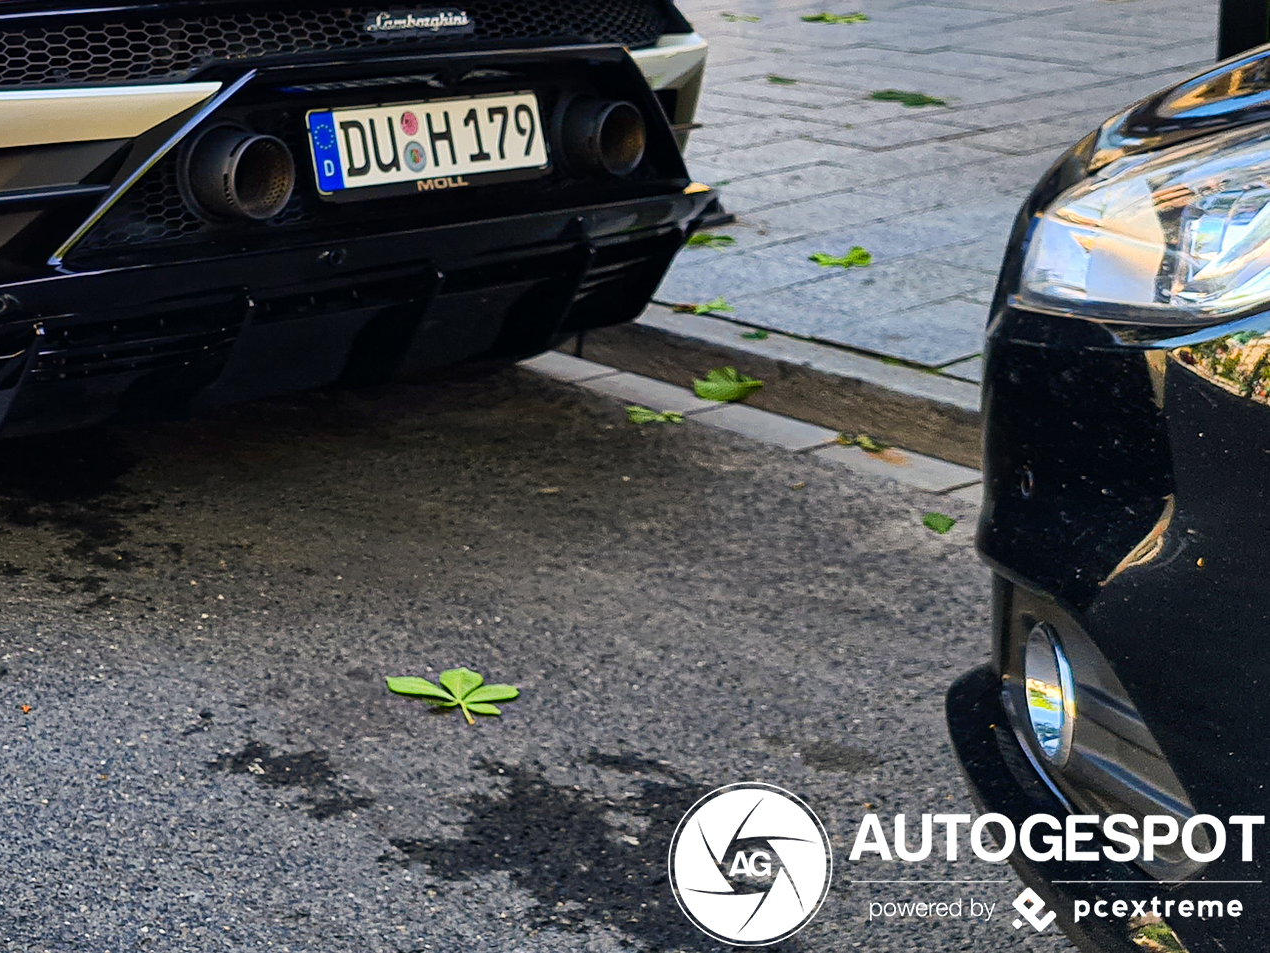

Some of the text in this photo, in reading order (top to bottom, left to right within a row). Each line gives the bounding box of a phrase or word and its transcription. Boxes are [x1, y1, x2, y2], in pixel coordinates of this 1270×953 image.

[366, 11, 470, 32] Lamborghini
[339, 103, 537, 178] DU H 179
[416, 175, 469, 192] MOLL
